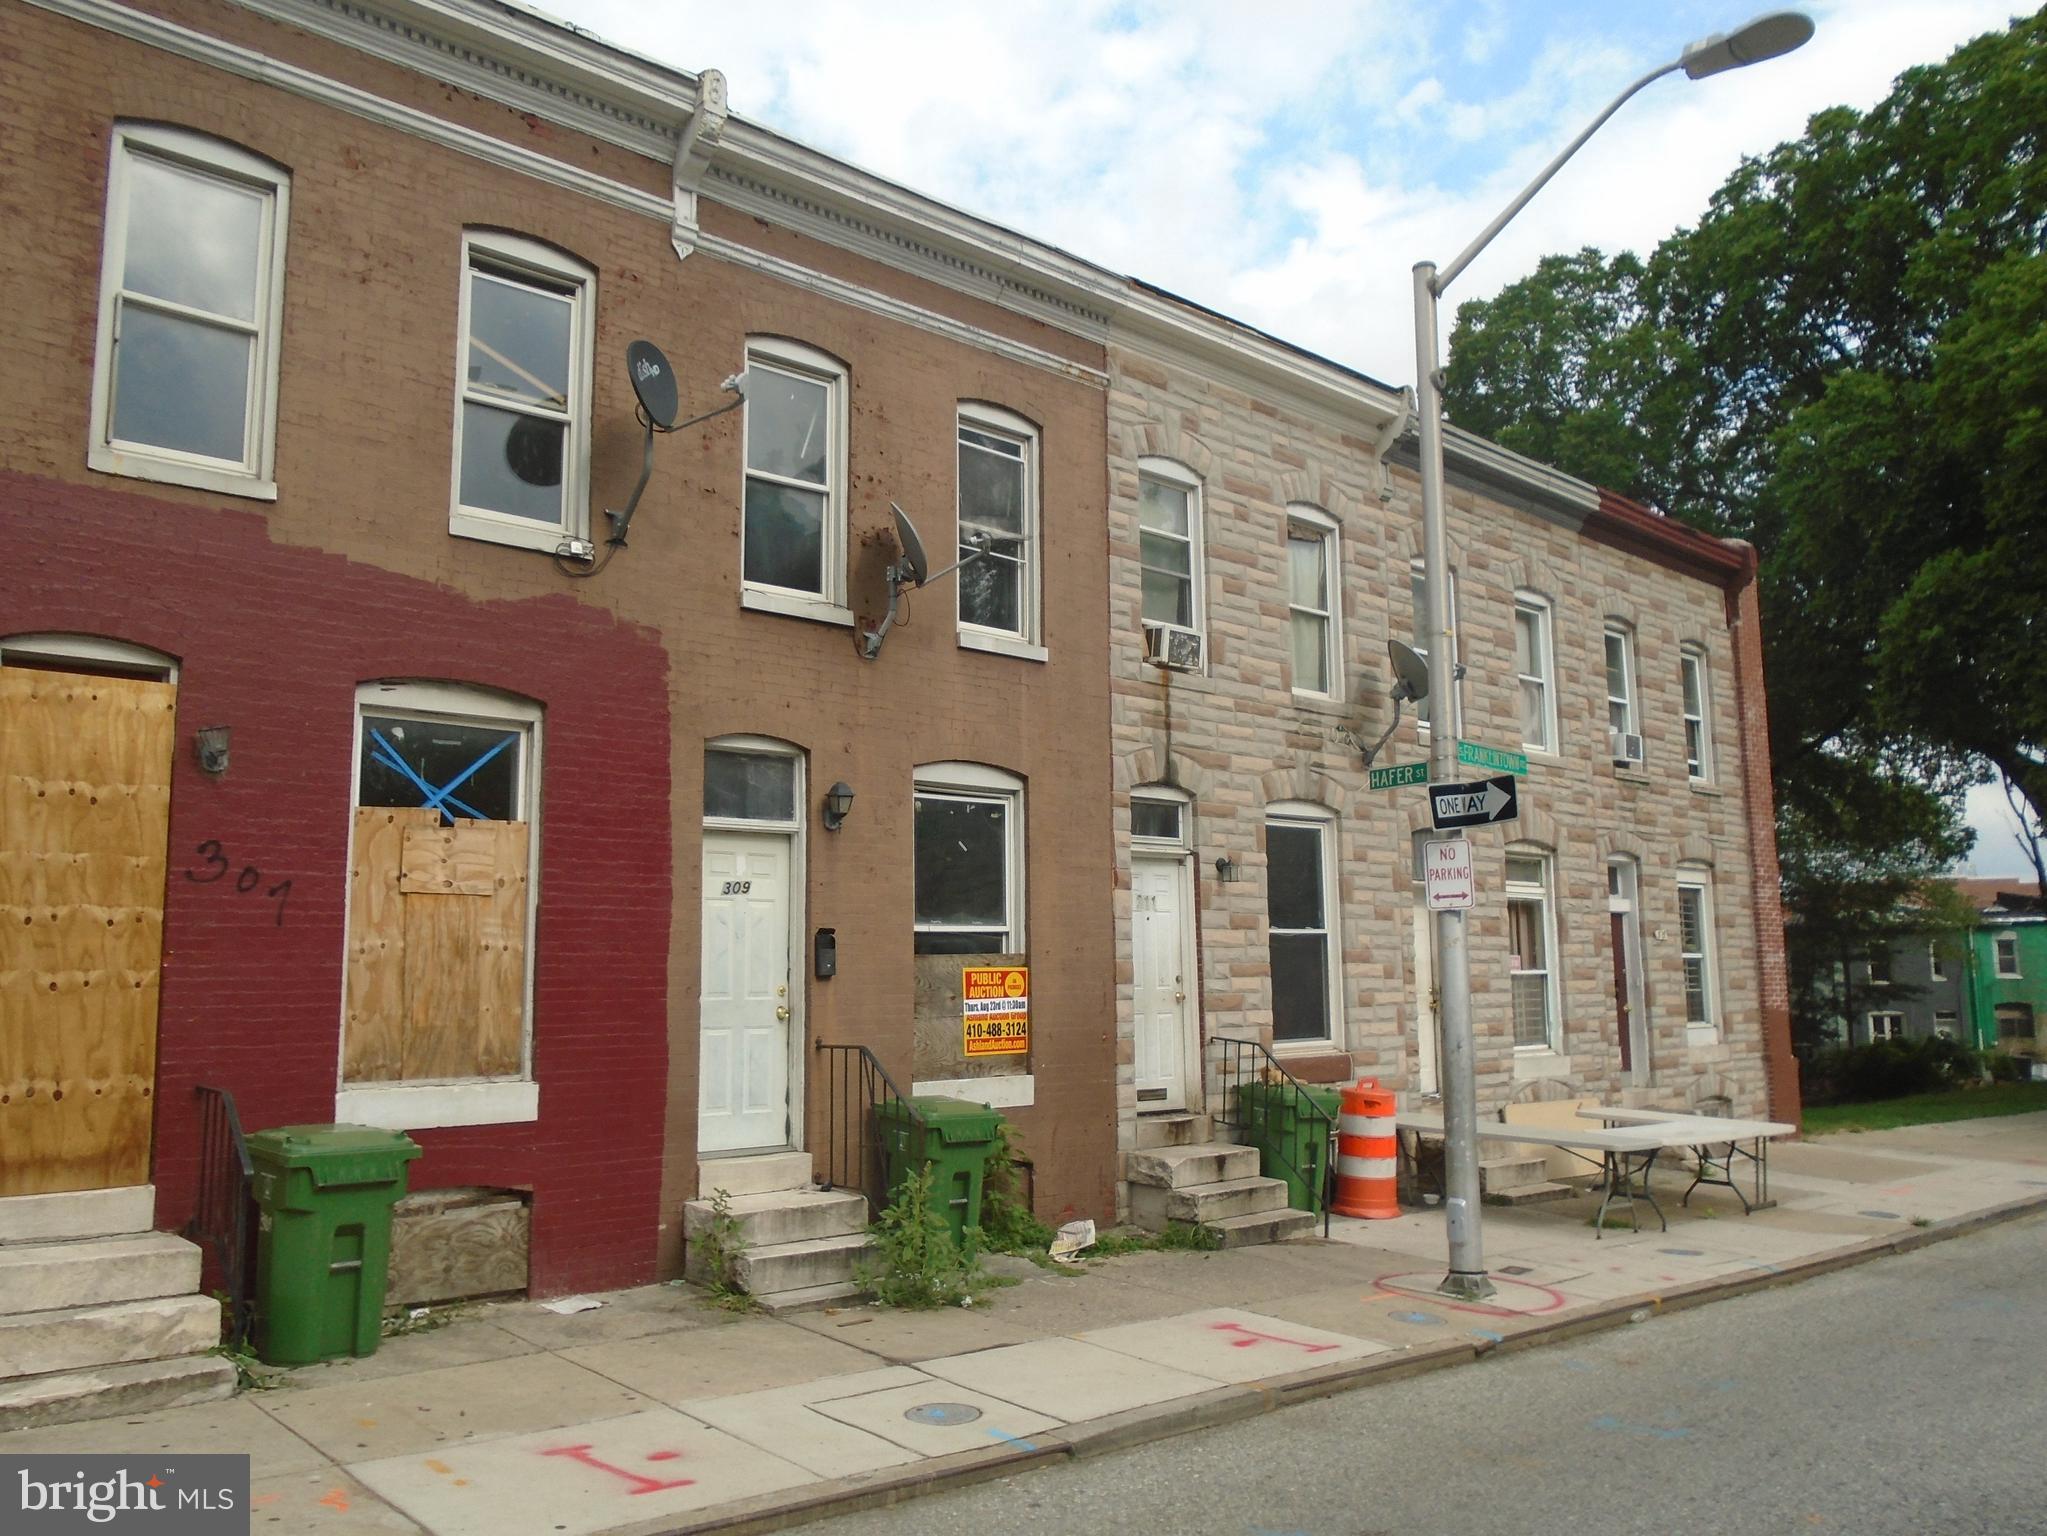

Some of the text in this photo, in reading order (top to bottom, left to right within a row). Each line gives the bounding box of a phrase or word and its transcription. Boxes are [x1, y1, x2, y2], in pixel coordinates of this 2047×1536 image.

[1371, 766, 1425, 790] HAFER ST
[1440, 796, 1460, 815] ONE
[1440, 847, 1456, 861] NO
[1429, 866, 1469, 881] PARKING
[723, 881, 751, 895] 309
[971, 972, 1002, 985] PUBLIC
[969, 985, 1004, 998] AUCTION
[980, 1002, 989, 1012] Aug
[990, 1001, 1001, 1011] 23rd
[966, 1022, 1027, 1037] 410-488-3124
